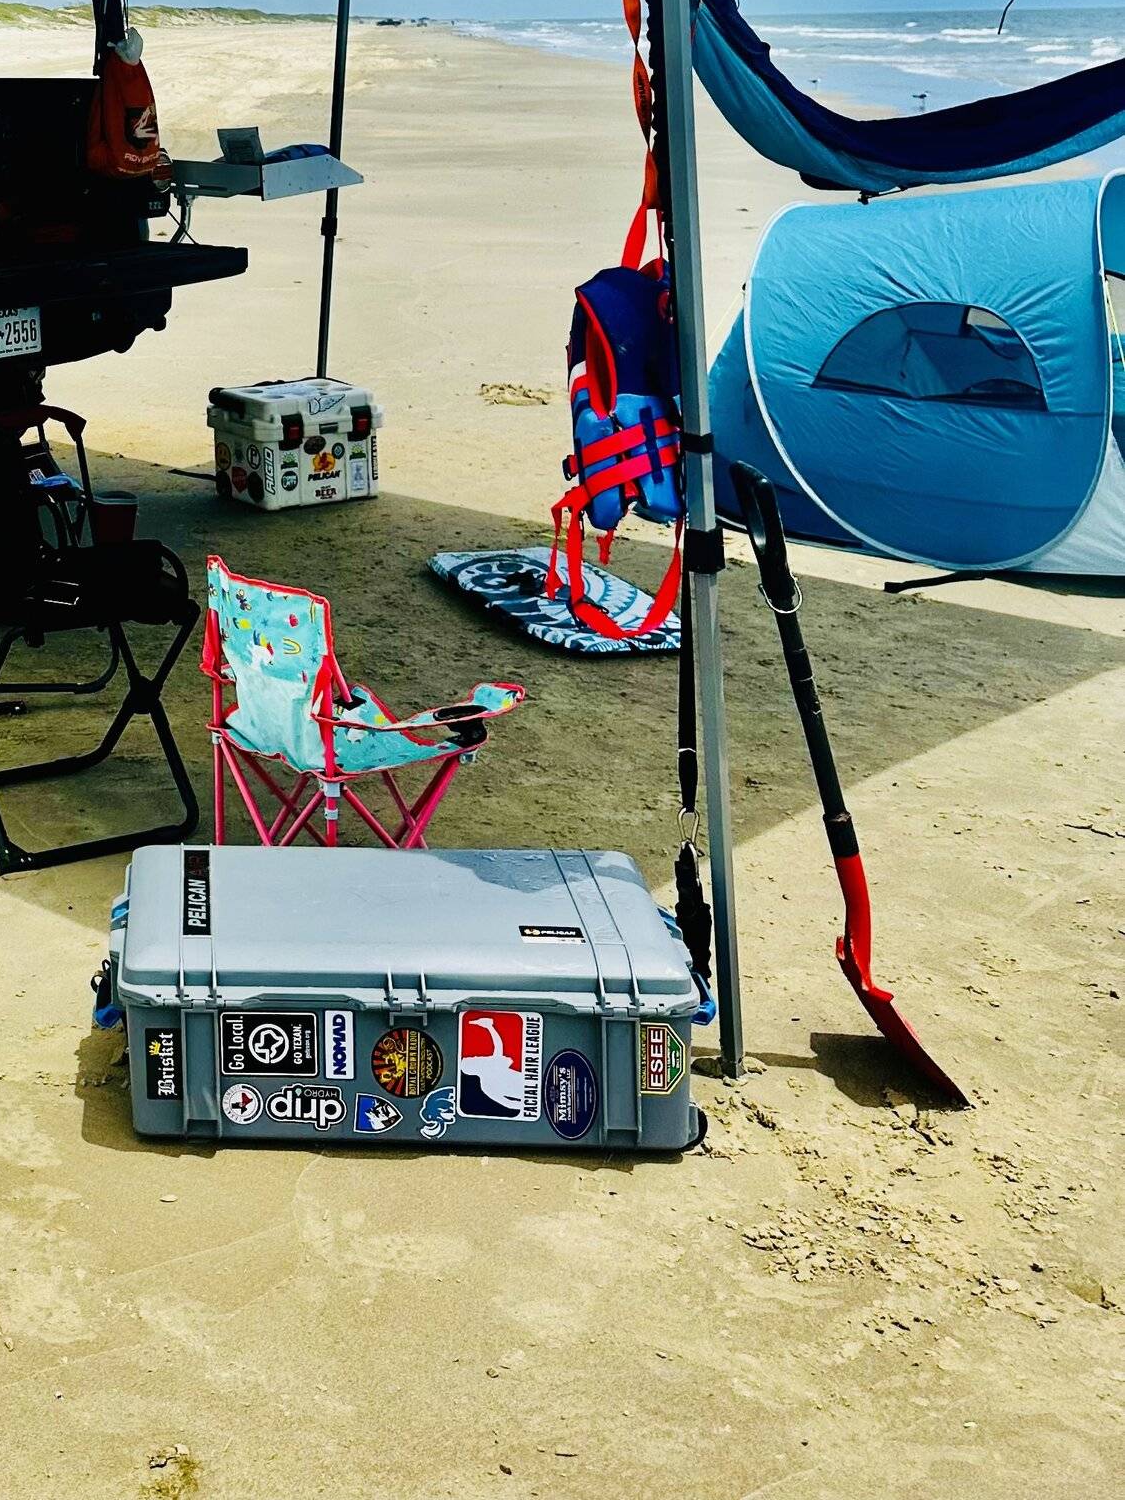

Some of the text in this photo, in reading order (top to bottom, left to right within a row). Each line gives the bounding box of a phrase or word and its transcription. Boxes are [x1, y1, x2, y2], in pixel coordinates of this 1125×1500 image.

[307, 470, 341, 482] PELICAN
[315, 488, 337, 497] BEER
[188, 879, 207, 927] PELICAN
[158, 1032, 178, 1096] Brisket
[226, 1015, 245, 1070] Go Local.
[293, 1052, 302, 1065] GO
[332, 1014, 347, 1076] NOMAD
[409, 1031, 417, 1096] ROYAL CROWN RADIO
[524, 1016, 540, 1118] FACIAL HAIR LEAGUE
[650, 1029, 663, 1087] ESEE
[272, 1089, 343, 1126] drip
[304, 1088, 338, 1098] HYDRO
[558, 1067, 567, 1122] Mimsy's
